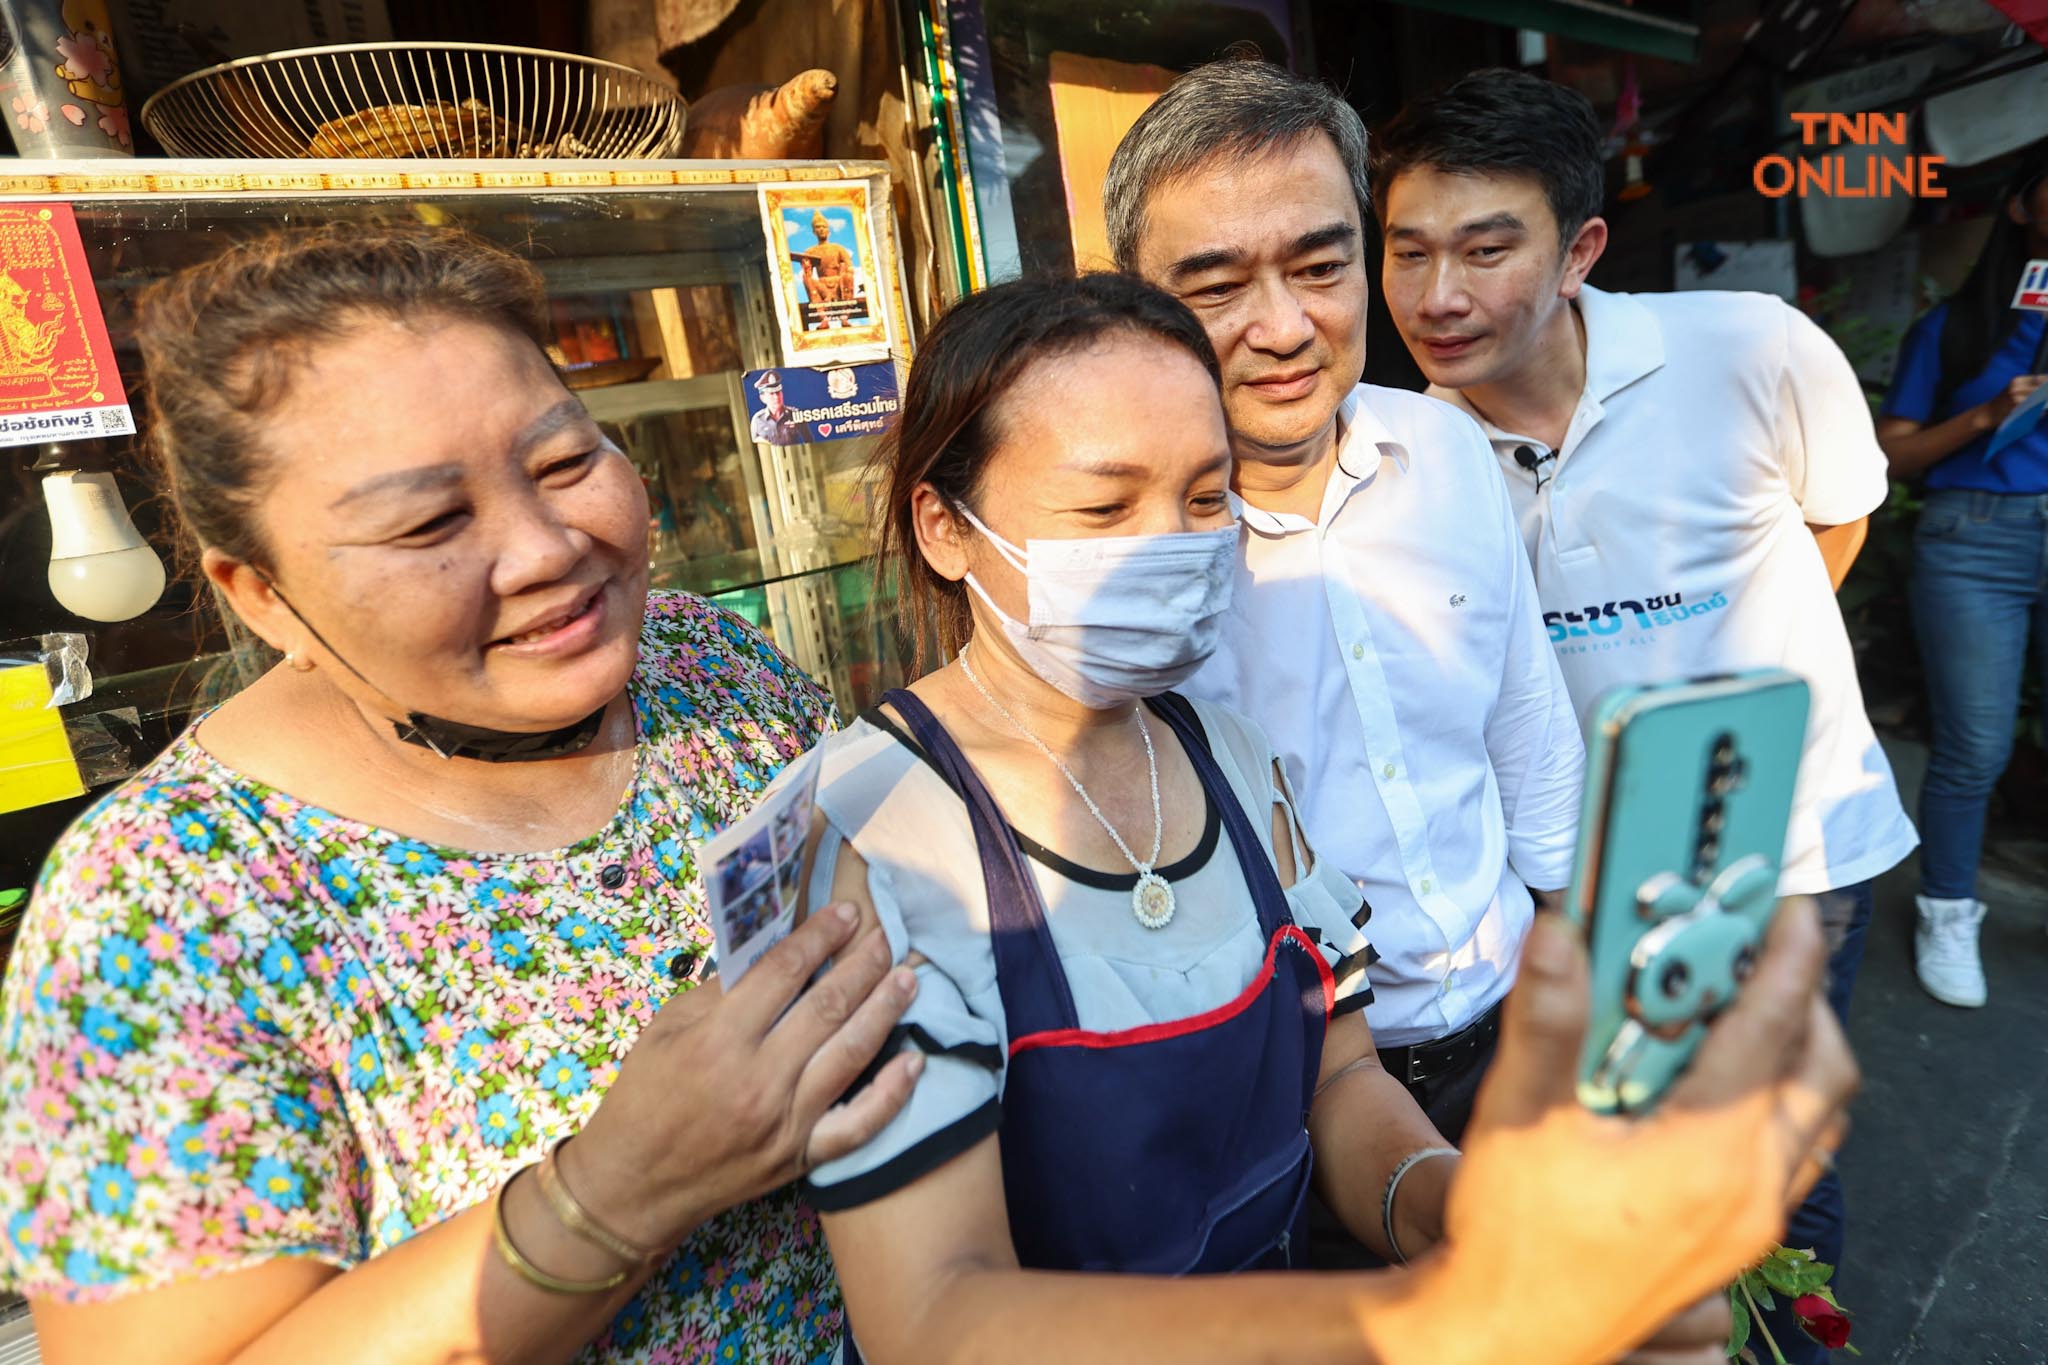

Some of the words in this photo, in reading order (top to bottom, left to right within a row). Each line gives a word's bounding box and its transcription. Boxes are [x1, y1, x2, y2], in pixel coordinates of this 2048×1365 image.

[792, 396, 898, 424] พรรคเสรีรวมไทย
